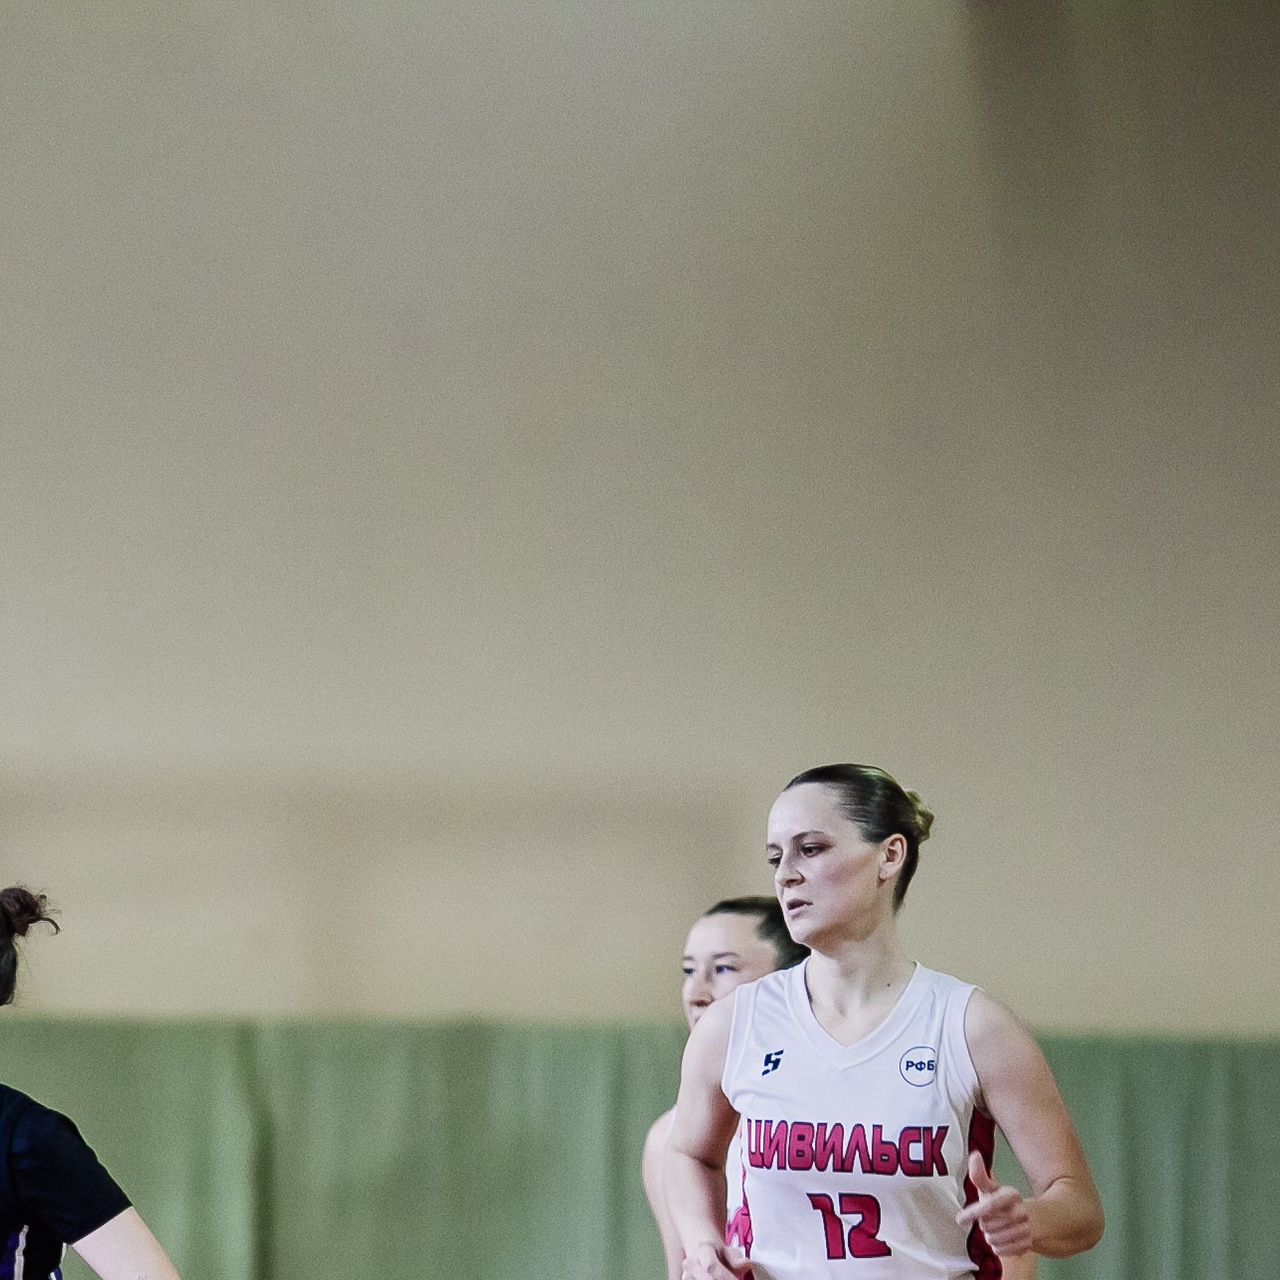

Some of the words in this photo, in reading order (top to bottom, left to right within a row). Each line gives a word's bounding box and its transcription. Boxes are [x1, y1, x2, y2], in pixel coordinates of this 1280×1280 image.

[904, 1059, 936, 1072] РФБ
[746, 1117, 950, 1178] ЦИВИЛЬСК
[805, 1191, 893, 1261] 12
